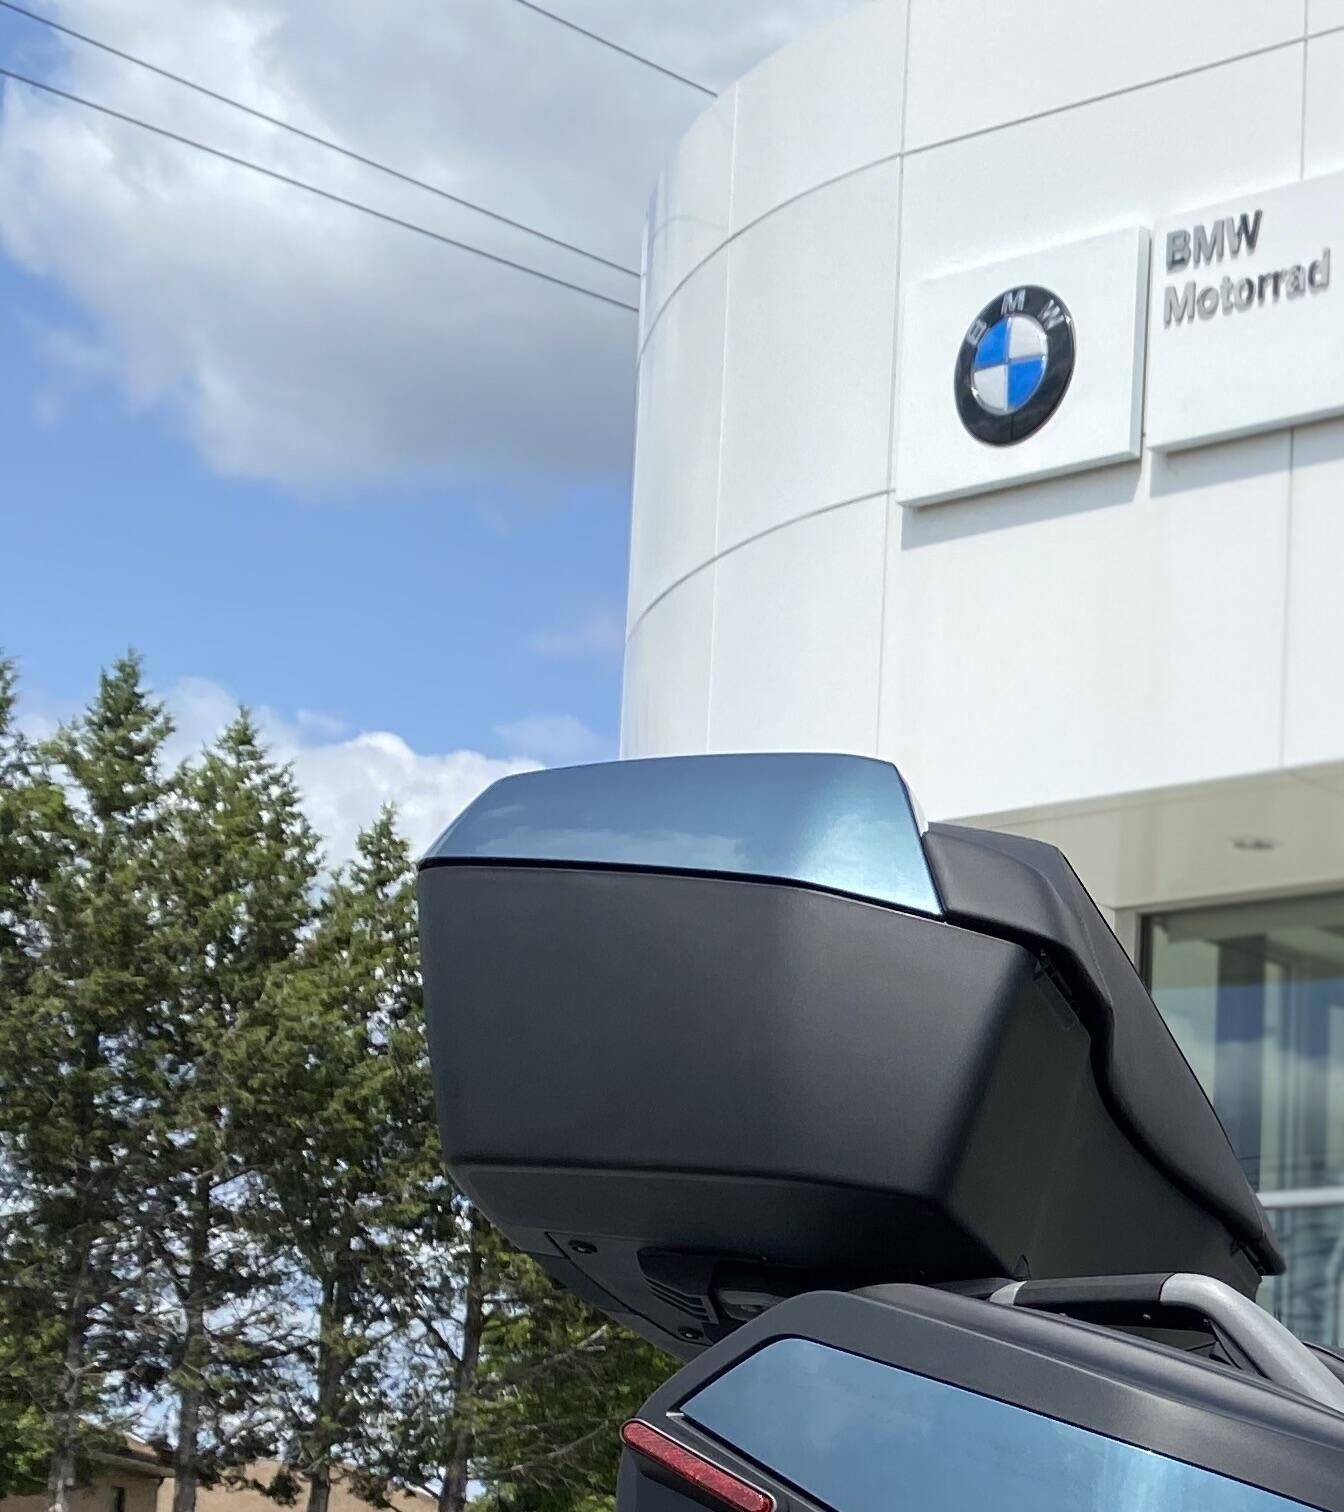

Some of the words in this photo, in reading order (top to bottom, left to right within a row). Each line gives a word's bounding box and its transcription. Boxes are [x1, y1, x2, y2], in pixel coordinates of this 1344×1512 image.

[1165, 209, 1264, 275] BMW
[965, 287, 1066, 347] BMW
[1161, 248, 1333, 330] Motorrad
